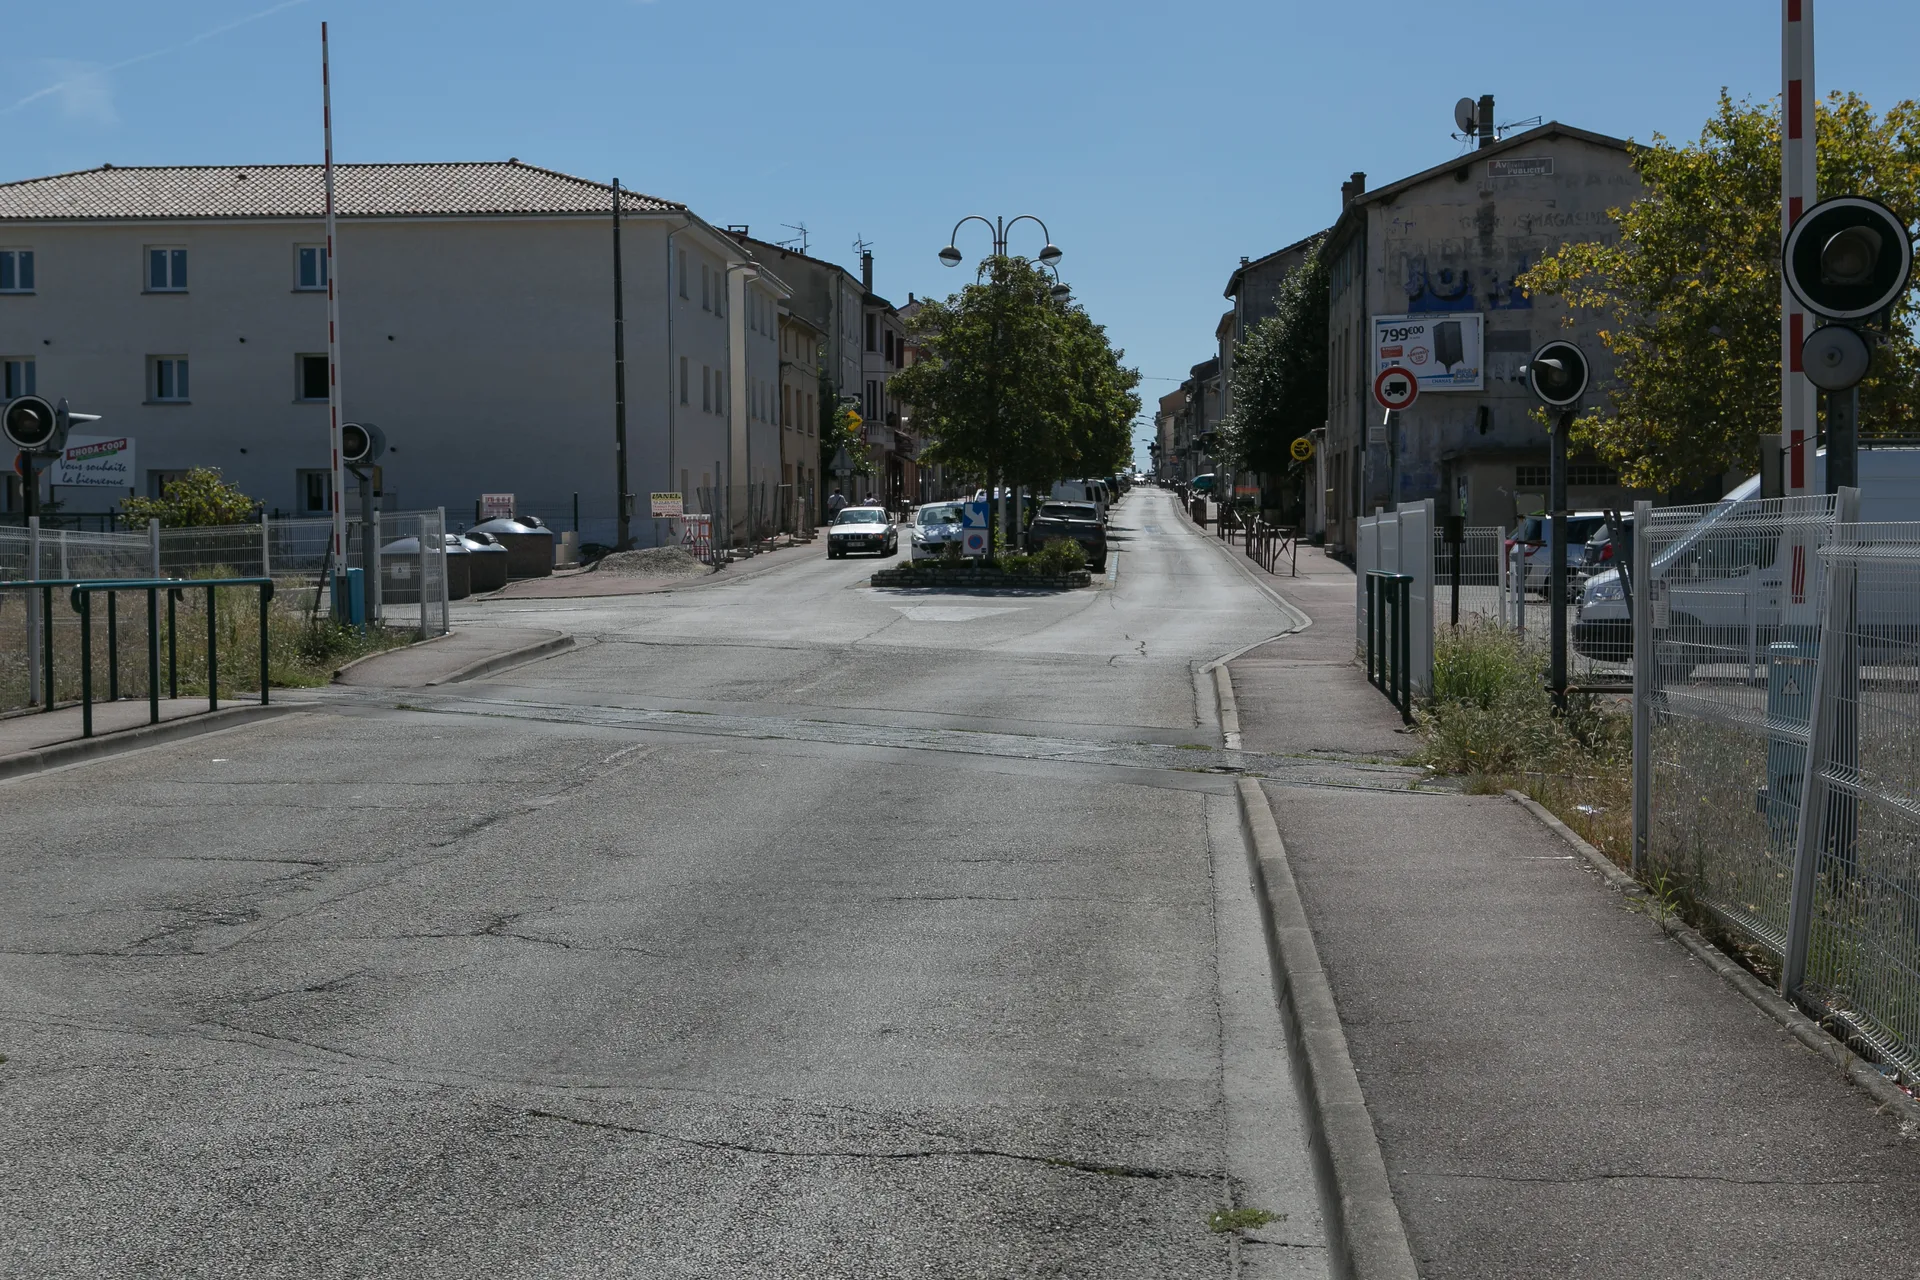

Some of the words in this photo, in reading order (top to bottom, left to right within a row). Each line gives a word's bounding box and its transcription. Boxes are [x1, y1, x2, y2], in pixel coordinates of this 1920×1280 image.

[69, 440, 125, 458] RHODA-COOP
[60, 458, 83, 471] Vous
[76, 473, 125, 485] bienvenue
